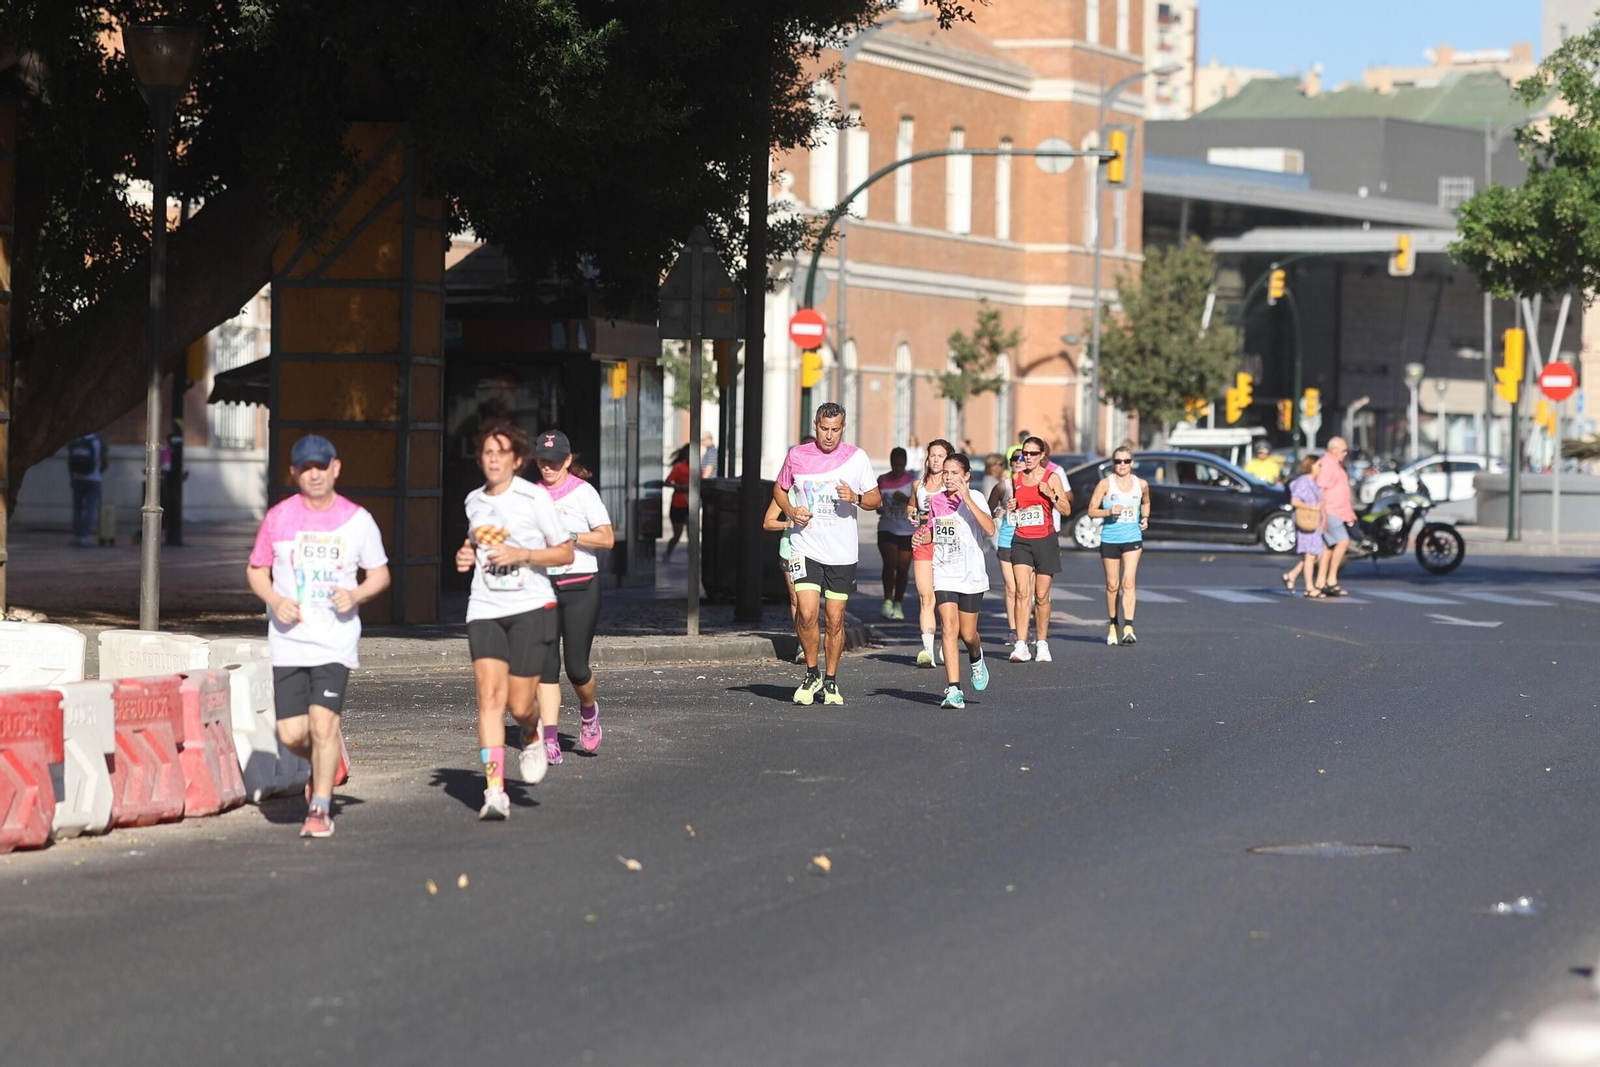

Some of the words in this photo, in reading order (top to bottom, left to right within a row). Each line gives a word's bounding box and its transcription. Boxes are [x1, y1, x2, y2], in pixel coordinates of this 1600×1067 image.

[1020, 511, 1040, 521] 233
[936, 525, 955, 536] 246
[303, 545, 340, 560] 699
